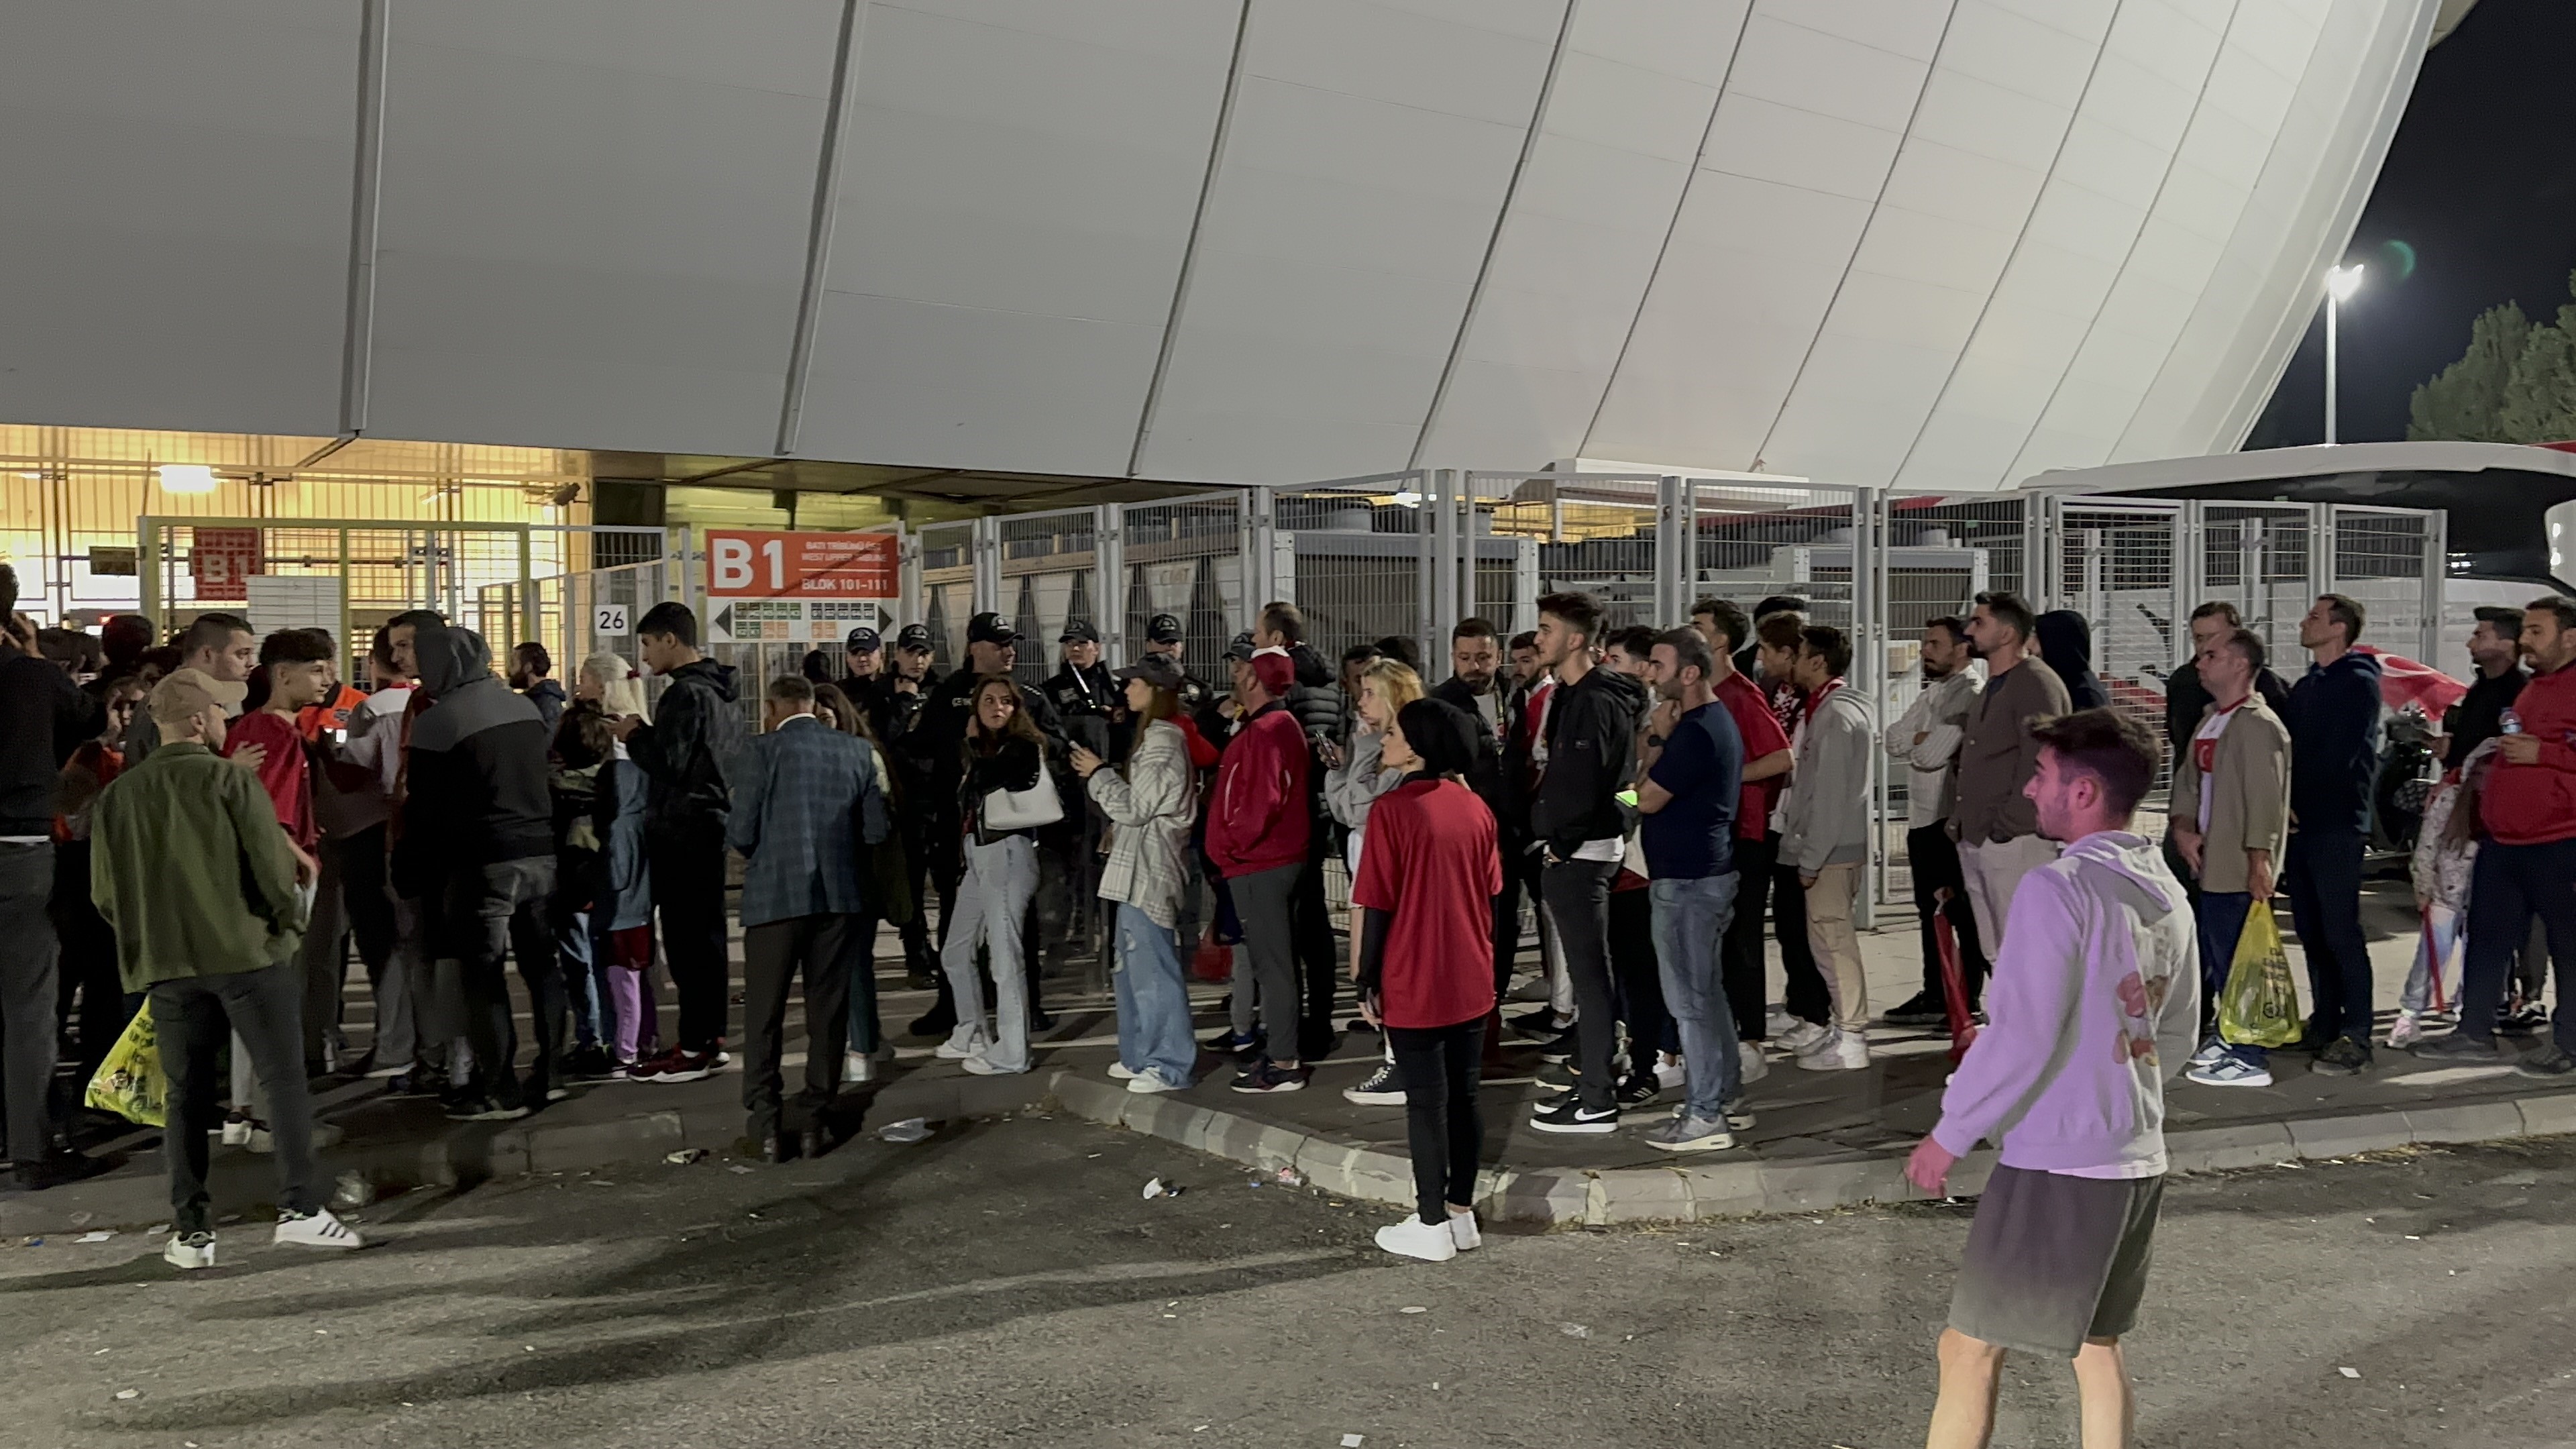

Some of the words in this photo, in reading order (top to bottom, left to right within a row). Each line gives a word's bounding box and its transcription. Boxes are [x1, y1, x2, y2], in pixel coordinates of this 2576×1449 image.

[203, 554, 249, 582] B1
[712, 538, 784, 589] B1
[802, 578, 837, 590] BLOK
[840, 578, 888, 590] 101-111
[599, 611, 624, 629] 26
